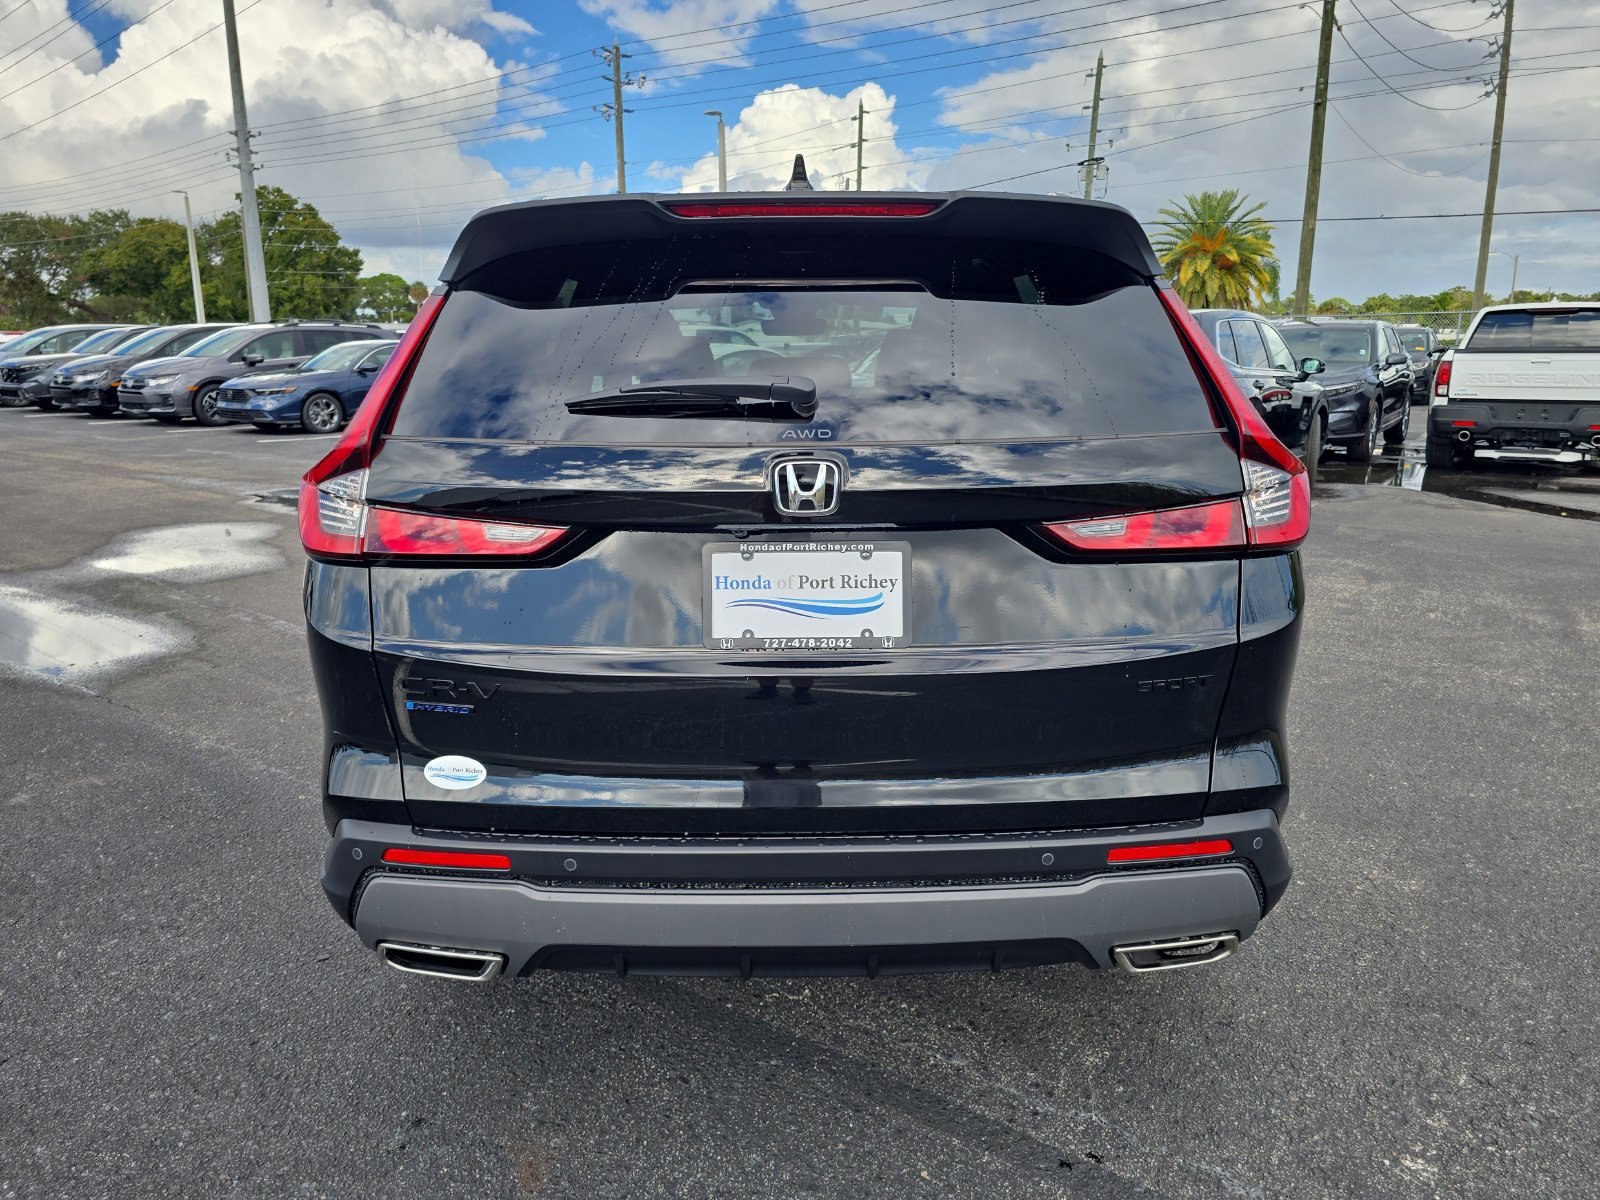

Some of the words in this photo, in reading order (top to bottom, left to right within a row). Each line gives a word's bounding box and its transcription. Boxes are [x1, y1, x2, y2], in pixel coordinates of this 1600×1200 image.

[1466, 373, 1600, 386] RIDGELIN
[782, 429, 832, 439] AWD
[739, 543, 874, 553] HondaofPortRichey.com
[715, 575, 772, 590] Honda
[776, 574, 795, 590] of
[799, 575, 836, 590] Port
[840, 574, 898, 593] Richey
[764, 638, 853, 648] 727-478-2042
[398, 677, 501, 700] CR-V
[1137, 674, 1214, 692] SPORT
[414, 703, 470, 714] HYBRID
